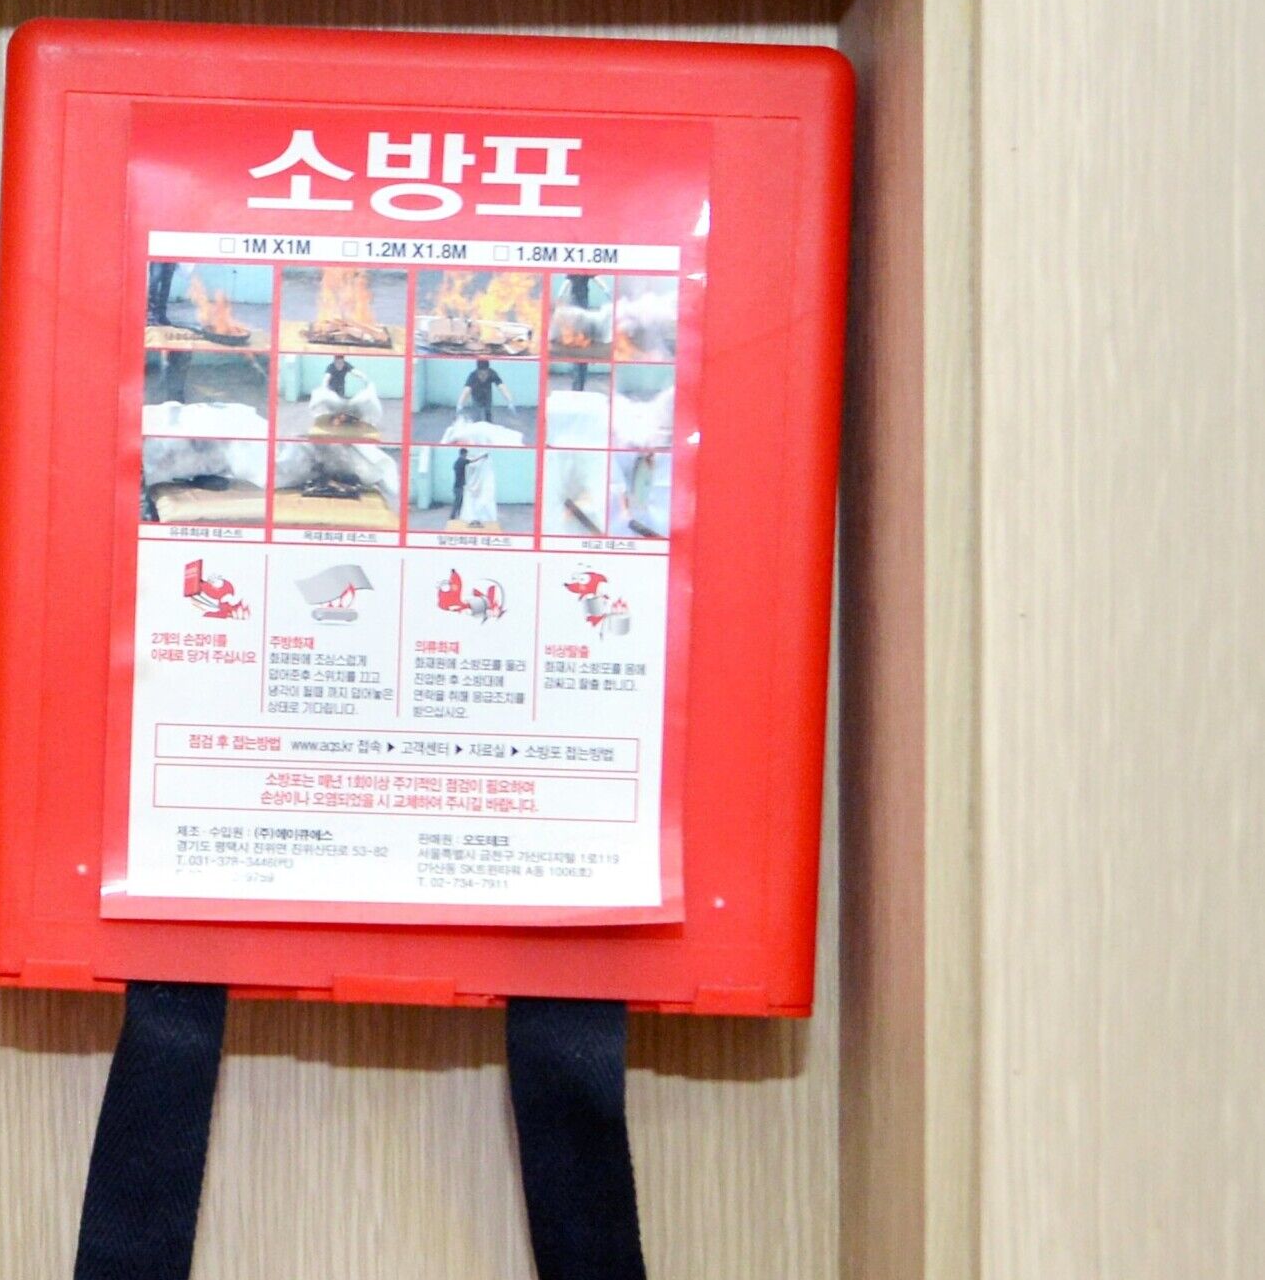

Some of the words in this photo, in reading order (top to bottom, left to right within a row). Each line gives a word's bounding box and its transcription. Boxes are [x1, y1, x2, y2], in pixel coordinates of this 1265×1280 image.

[246, 129, 584, 222] 소방포
[242, 238, 269, 256] 1M
[272, 238, 312, 257] X1M
[364, 241, 407, 259] 1.2M
[411, 242, 468, 260] X1.8M
[517, 245, 560, 263] 1.8M
[563, 246, 619, 264] X1.8M
[213, 528, 243, 539] 테스트
[347, 532, 378, 543] 테스트
[481, 536, 512, 547] 테스트
[605, 540, 636, 551] 테스트
[151, 632, 181, 646] 2개의
[183, 633, 228, 648] 손잡이를
[270, 636, 315, 650] 주방화재
[151, 649, 184, 662] 아래로
[314, 654, 367, 667] 조심스럽게
[460, 658, 502, 671] 소방포를
[578, 662, 621, 675] 소방포를
[313, 670, 356, 683] 스위치를
[449, 674, 459, 685] 후
[267, 701, 299, 714] 상태로
[188, 733, 213, 750] 점검
[216, 734, 229, 750] 후
[232, 734, 282, 752] 접는방법
[357, 739, 383, 754] 접속
[401, 741, 450, 756] 고객센터
[468, 742, 506, 758] 자료실
[524, 745, 562, 760] 소방포
[566, 746, 615, 762] 접는방법
[265, 773, 315, 788] 소방포는
[347, 774, 390, 791] 1회이상
[393, 776, 443, 792] 주기적인
[446, 778, 483, 794] 점검이
[486, 779, 536, 795] 필요하여
[260, 790, 310, 806] 손상이나
[312, 791, 375, 808] 오염되었을
[377, 793, 390, 808] 시
[393, 794, 443, 810] 교체하여
[446, 796, 483, 812] 주시길
[177, 825, 199, 837] 제조
[177, 841, 211, 852] 경기도
[214, 842, 250, 853] 평택시
[352, 846, 389, 857] 53-82
[417, 848, 476, 861] 서울특별시
[480, 849, 514, 862] 금천구
